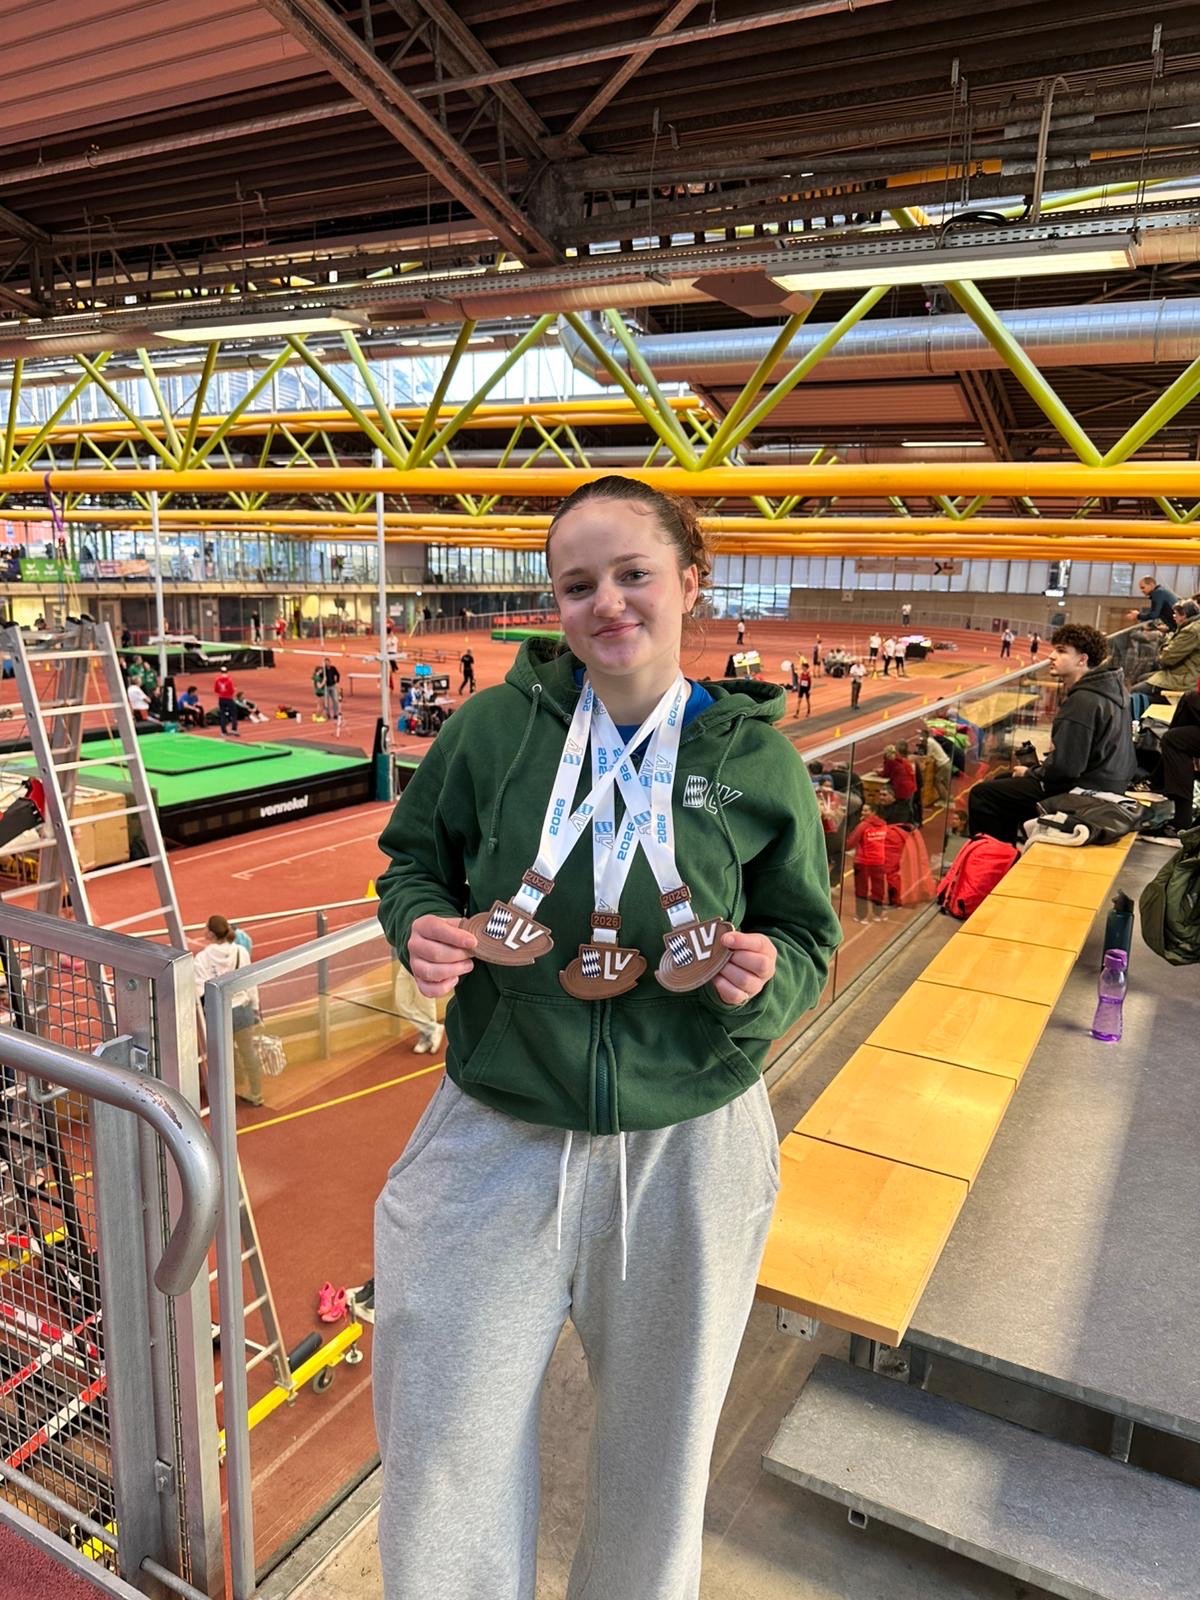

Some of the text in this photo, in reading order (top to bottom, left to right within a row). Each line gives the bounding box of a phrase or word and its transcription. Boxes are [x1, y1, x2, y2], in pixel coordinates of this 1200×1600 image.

[563, 738, 584, 766] BLV
[598, 747, 608, 780] 202
[654, 754, 676, 785] BLV
[682, 774, 743, 815] BLV
[549, 798, 566, 836] 2026
[569, 803, 594, 832] BLV
[657, 814, 667, 843] 2026
[594, 821, 614, 850] BLV
[617, 821, 635, 861] 2026
[527, 873, 551, 892] 2026
[662, 887, 688, 905] 2026
[484, 906, 545, 950] BLV
[593, 914, 619, 928] 2026
[669, 922, 717, 967] BLV
[582, 949, 634, 980] BLV
